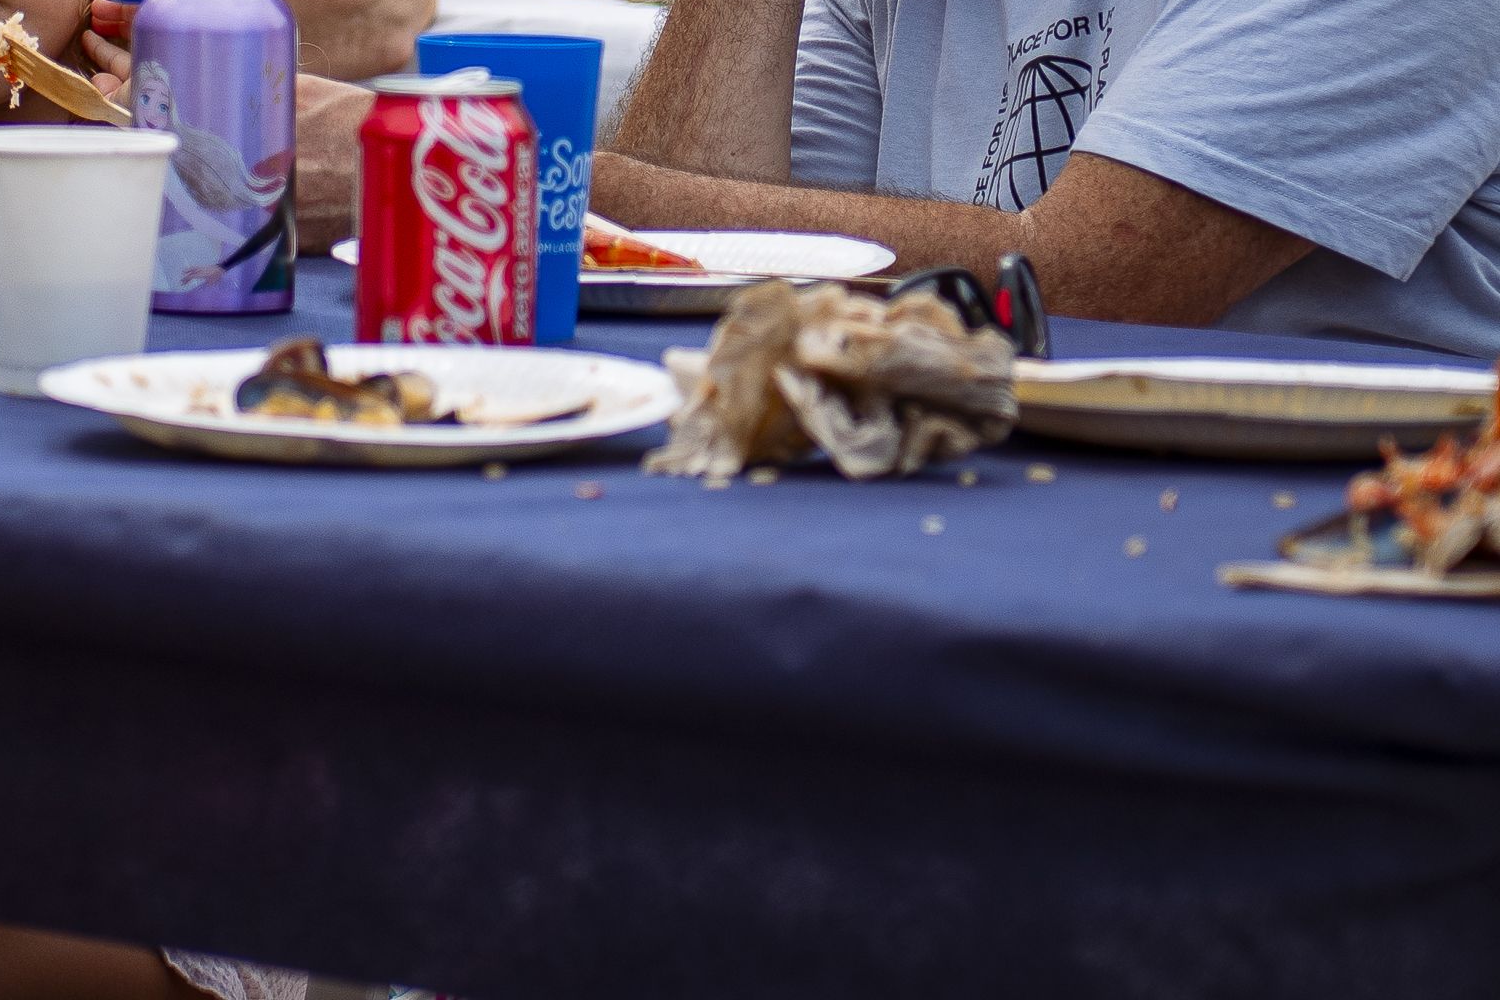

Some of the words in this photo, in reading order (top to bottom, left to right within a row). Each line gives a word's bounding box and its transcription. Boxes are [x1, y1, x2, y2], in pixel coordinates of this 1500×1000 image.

[1045, 16, 1091, 45] FOR
[982, 119, 1005, 170] FOR
[511, 261, 530, 338] zero
